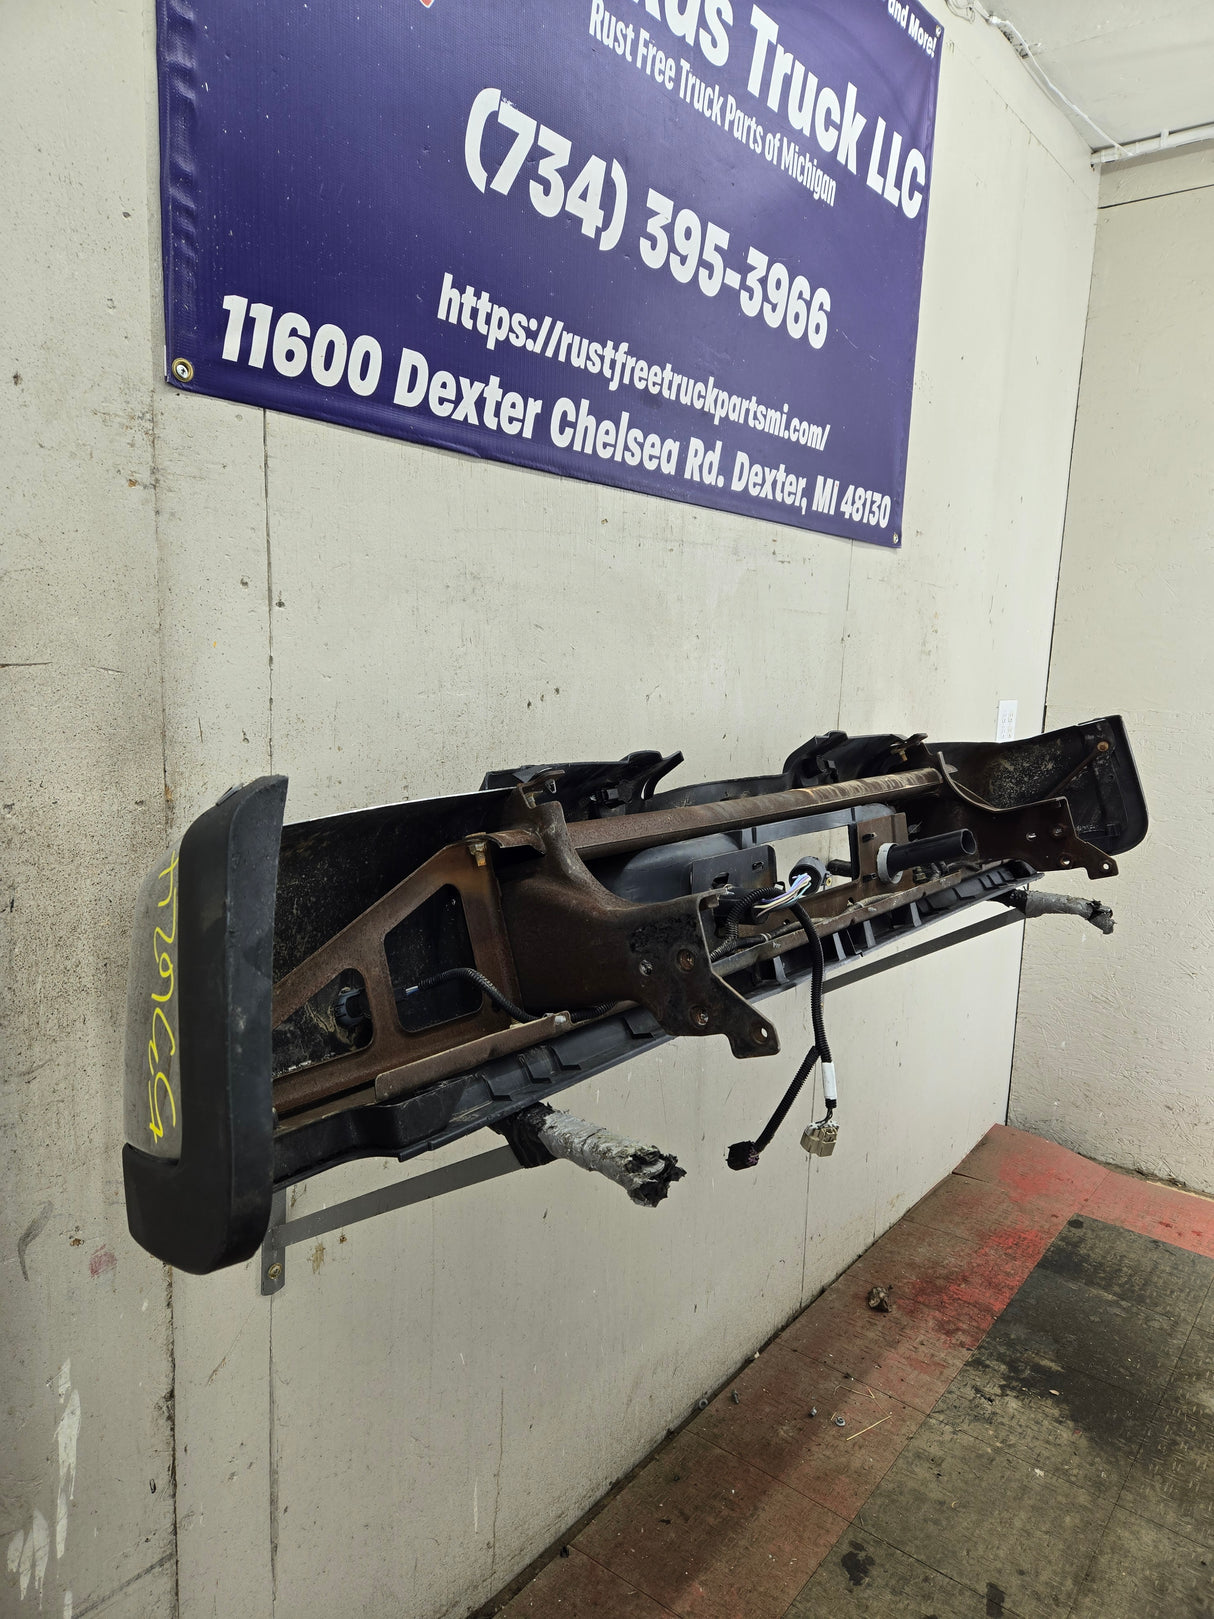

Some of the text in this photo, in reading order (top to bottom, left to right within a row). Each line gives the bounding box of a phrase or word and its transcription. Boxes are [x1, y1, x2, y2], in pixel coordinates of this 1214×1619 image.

[589, 0, 837, 207] Rust Free Truck Parts of Michigan
[746, 4, 868, 175] Truck
[866, 116, 926, 219] LLC
[887, 0, 937, 58] and More!
[464, 87, 831, 350] (734) 395-3966
[221, 294, 892, 529] 11600 Dexter Chelsea Rd. Dexter, MI 48130
[437, 272, 831, 452] https://rustfreetruckpartsmi.com/
[148, 849, 180, 1144] 53624
